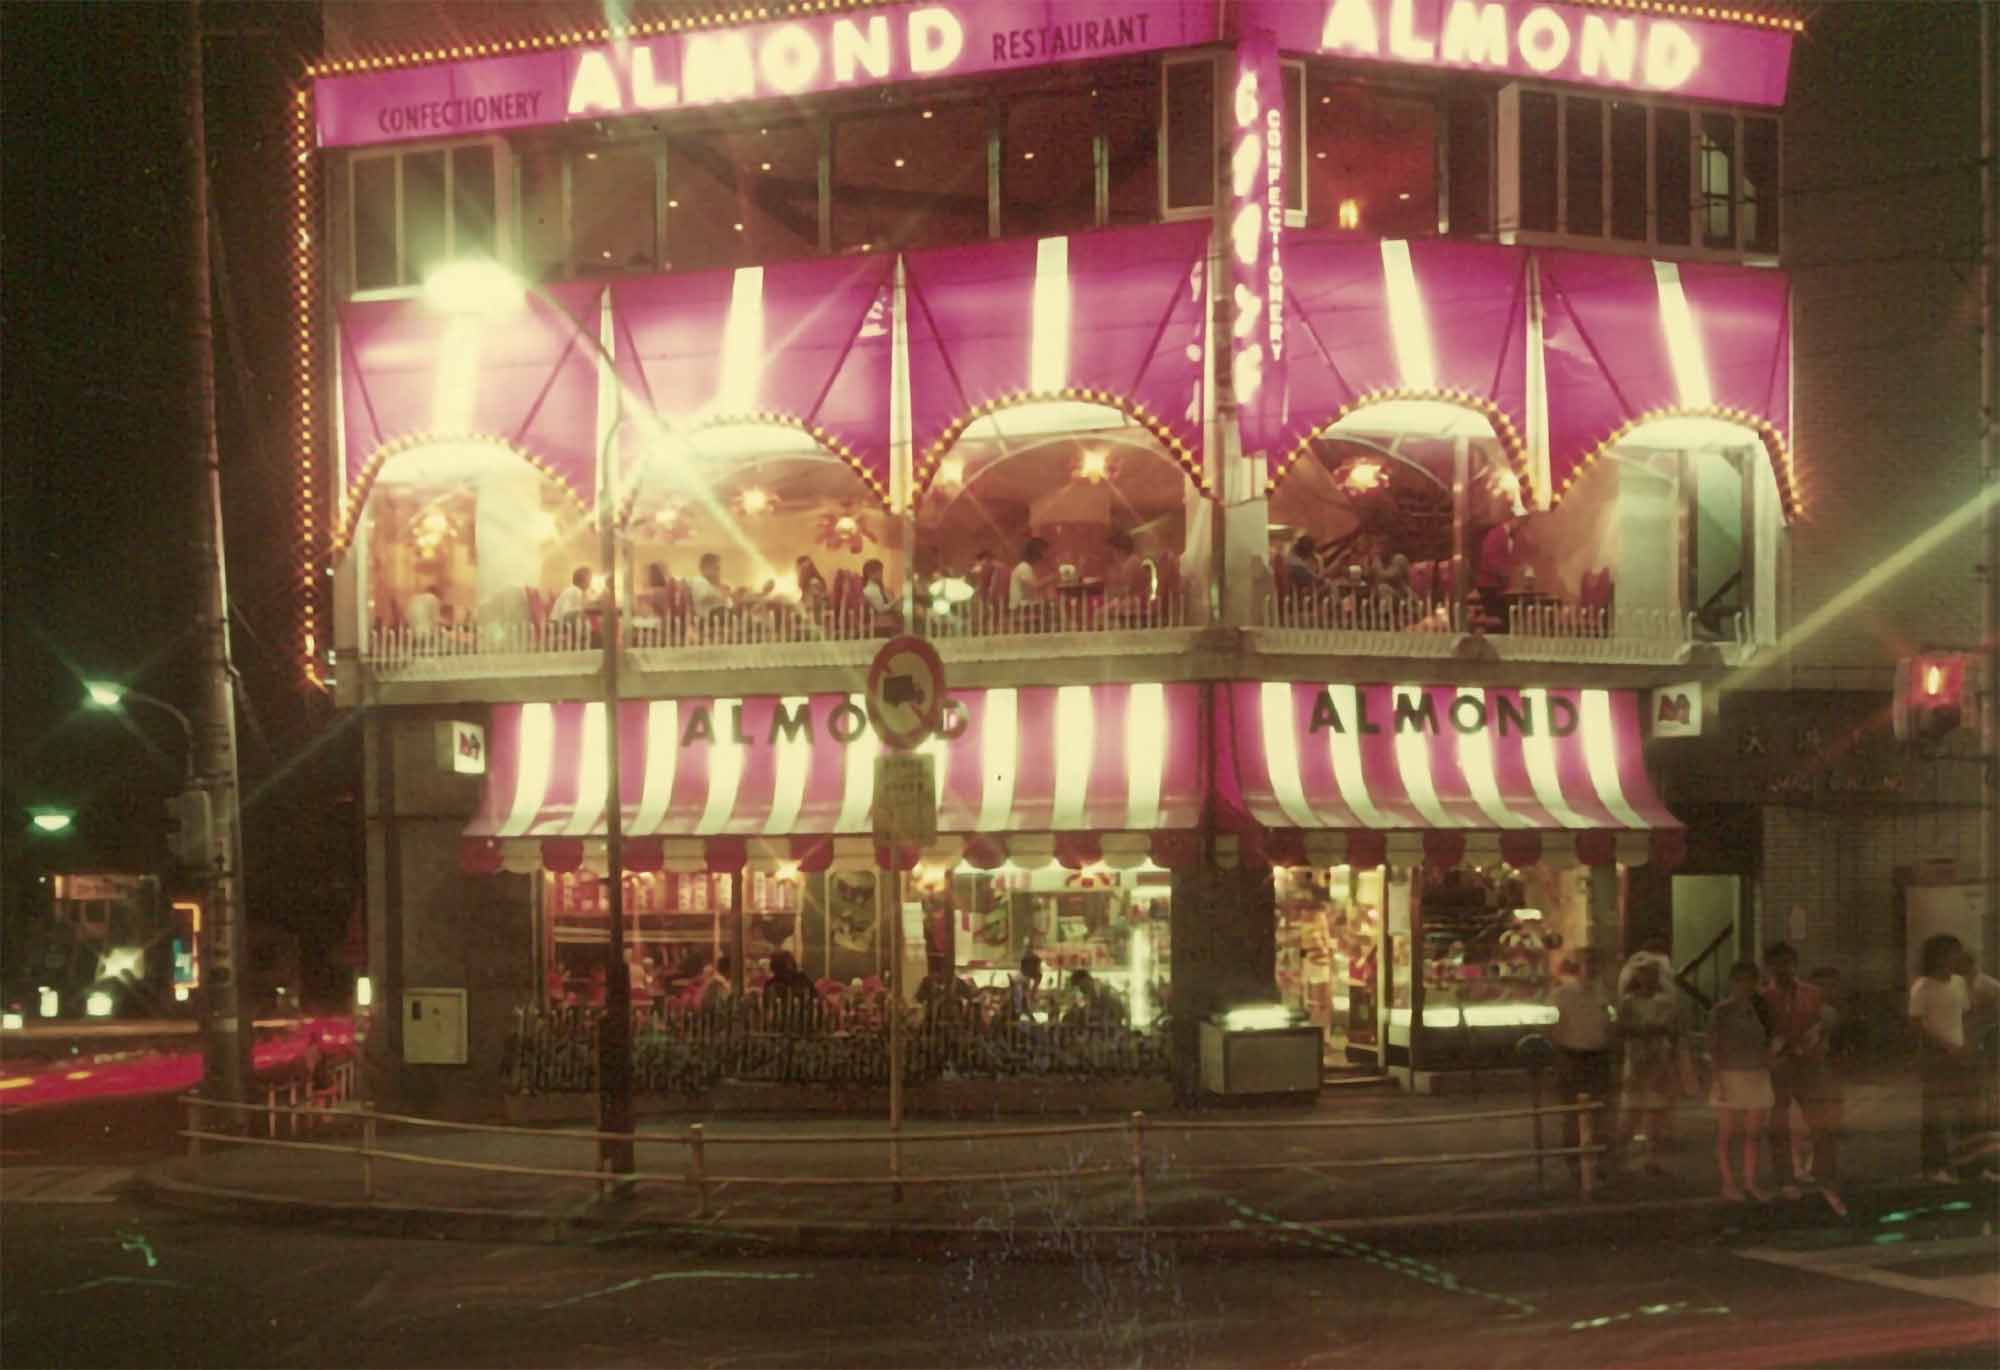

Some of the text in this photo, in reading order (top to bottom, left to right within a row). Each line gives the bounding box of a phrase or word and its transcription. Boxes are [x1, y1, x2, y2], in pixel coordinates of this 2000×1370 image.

[378, 7, 1150, 134] CONFECTIONERY ALMOND RESTAURANT
[1320, 0, 1701, 91] ALMOND
[681, 699, 965, 747] ALMOD
[1308, 684, 1580, 737] ALMOND
